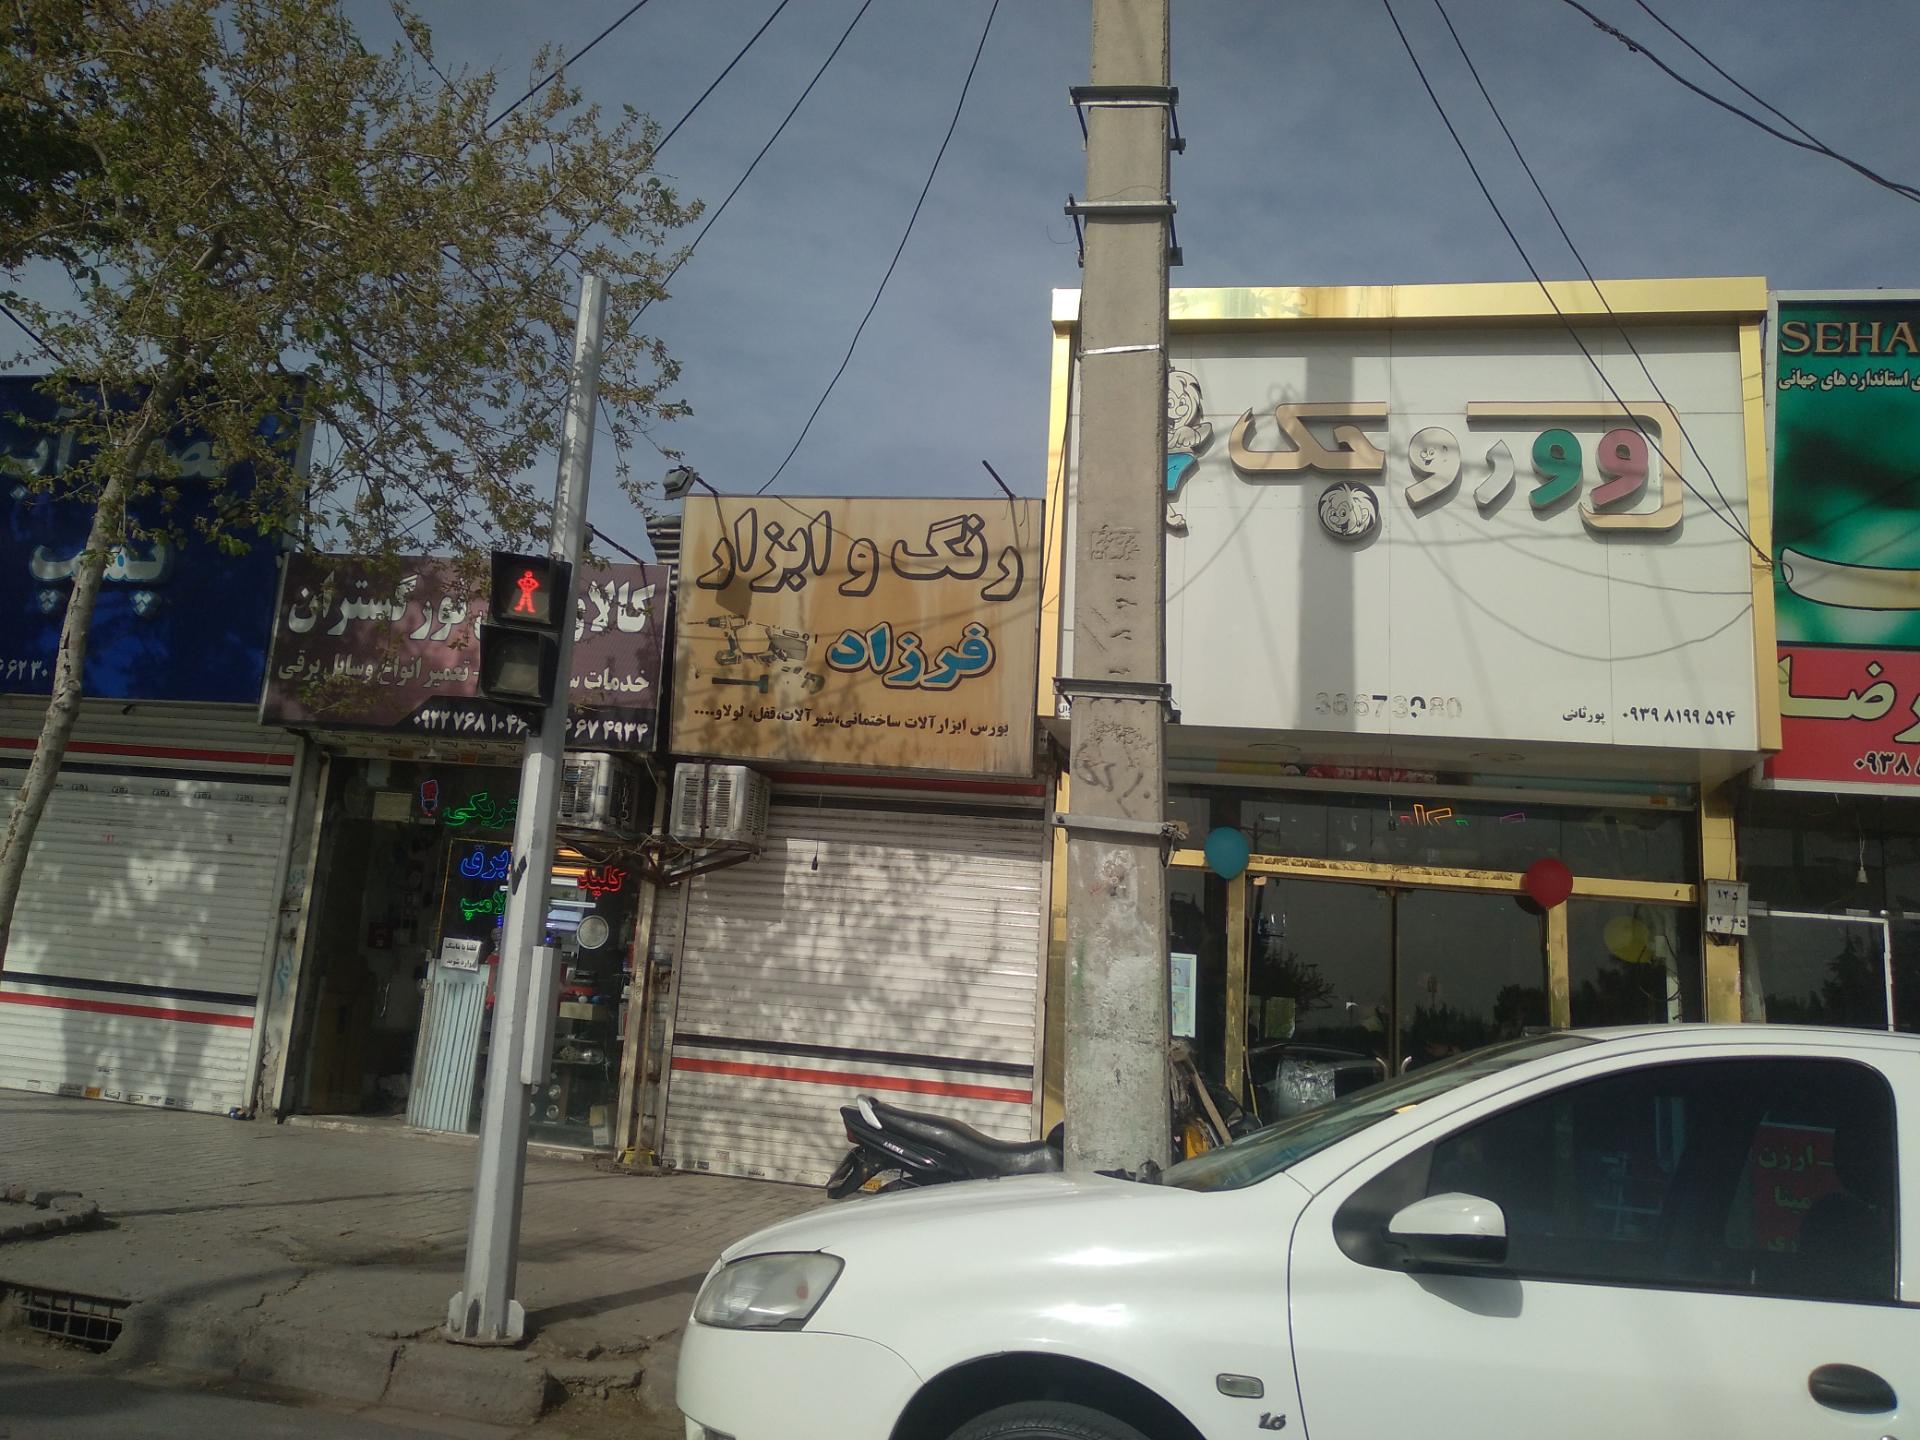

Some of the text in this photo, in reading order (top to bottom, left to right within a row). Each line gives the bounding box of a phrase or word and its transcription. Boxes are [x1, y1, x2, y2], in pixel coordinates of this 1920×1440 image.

[1778, 368, 1818, 391] جهانی
[1820, 369, 1847, 391] های
[1849, 369, 1910, 391] استاندارد
[695, 507, 832, 592] ابزار
[890, 513, 1024, 601] رنگ
[838, 537, 880, 597] و
[288, 570, 419, 637] گستران
[277, 648, 321, 682] برقی
[377, 655, 422, 688] انواع
[825, 620, 996, 692] فرزاد
[423, 660, 471, 689] تعمیر
[583, 667, 650, 693] خدمات
[904, 714, 937, 729] آلات
[936, 717, 967, 735] ابزار
[969, 722, 1009, 737] بورس
[460, 844, 509, 879] برق
